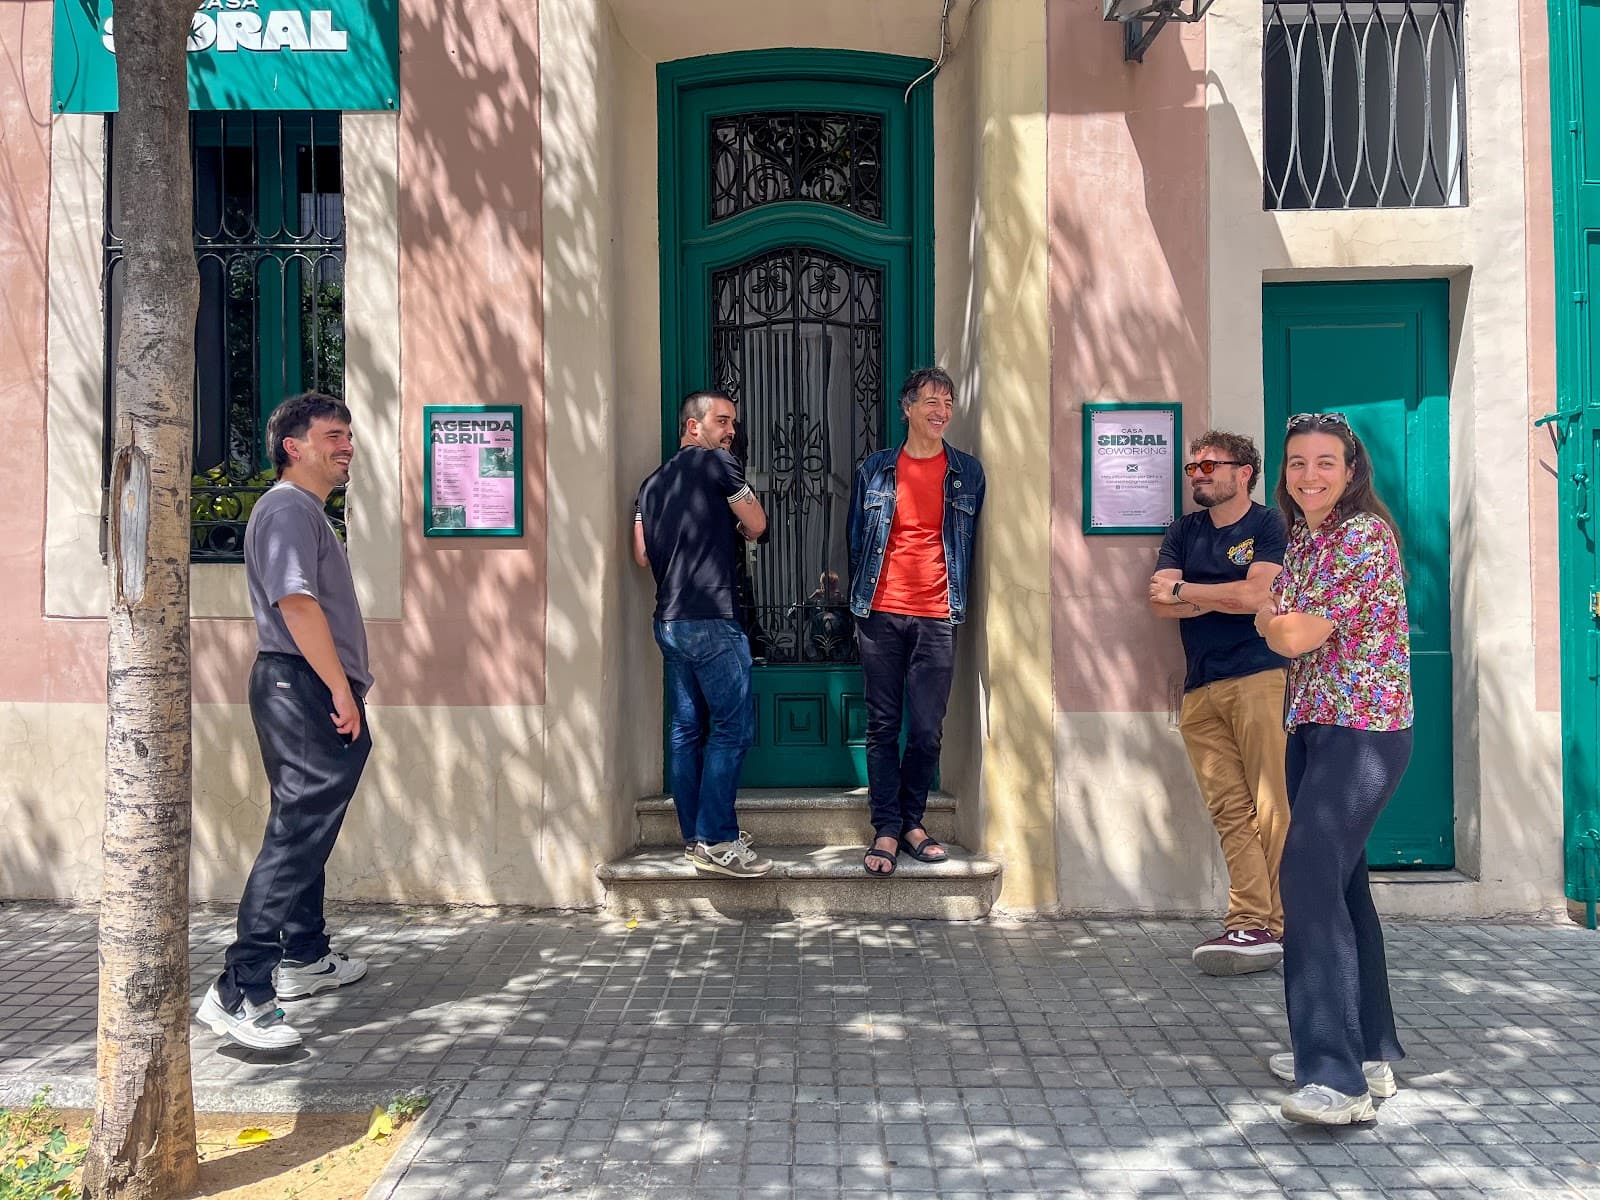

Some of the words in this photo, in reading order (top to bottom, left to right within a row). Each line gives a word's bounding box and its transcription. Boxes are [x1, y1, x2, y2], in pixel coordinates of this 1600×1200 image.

[102, 10, 348, 52] DRAL
[431, 420, 514, 431] AGENDA
[431, 433, 490, 444] ABRIL
[1097, 435, 1167, 446] SIDRAL
[1098, 447, 1167, 455] COWORKING
